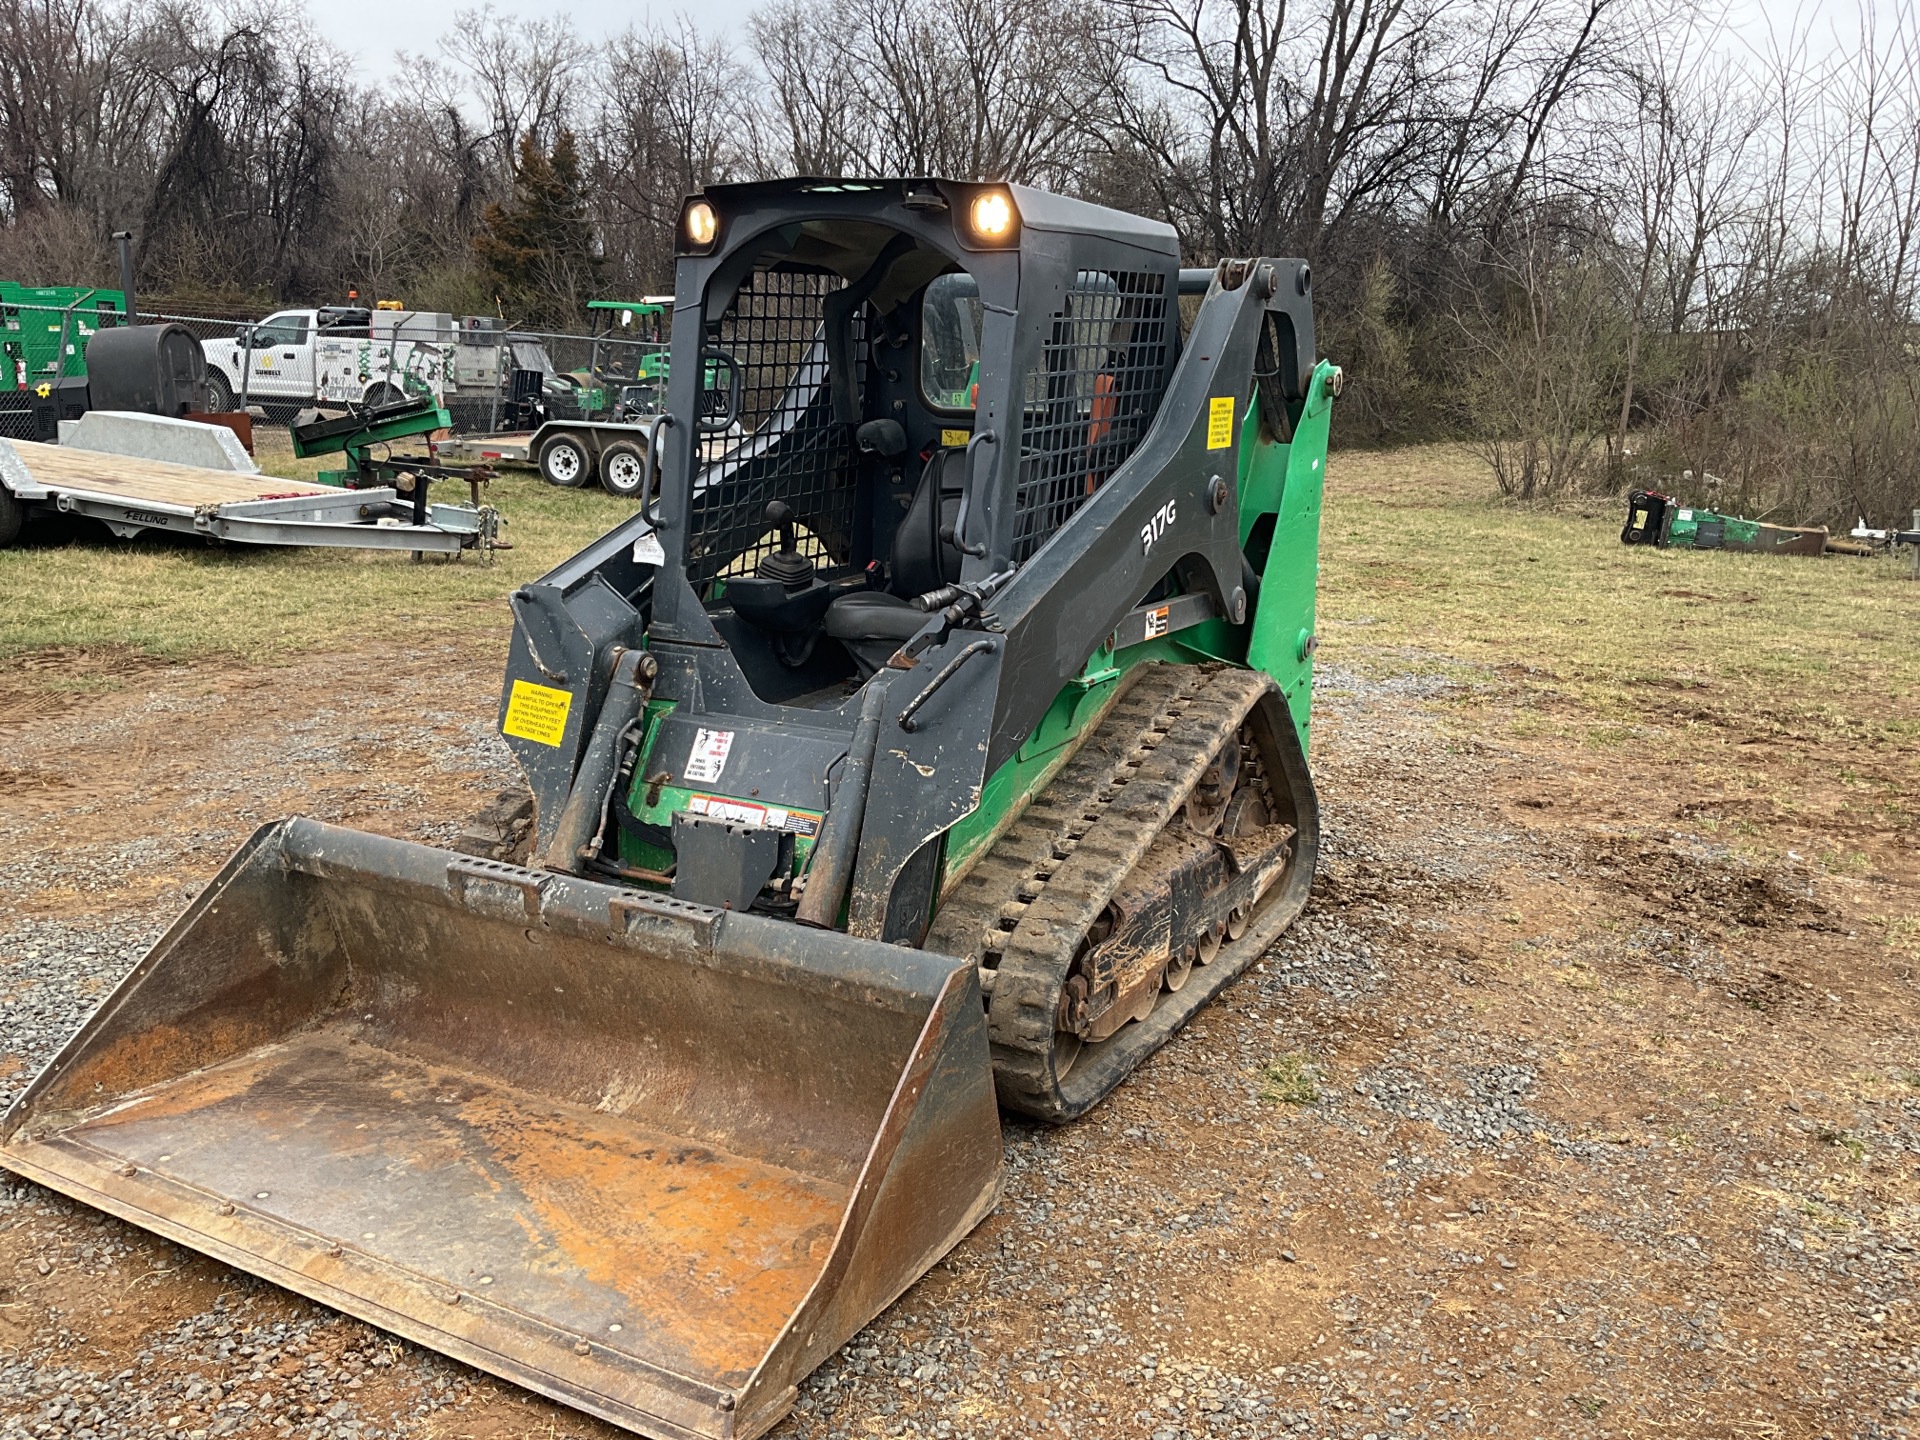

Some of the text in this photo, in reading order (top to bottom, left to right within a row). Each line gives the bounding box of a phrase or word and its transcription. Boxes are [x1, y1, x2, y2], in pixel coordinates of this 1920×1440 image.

[122, 510, 168, 526] FELLING
[1141, 498, 1176, 556] 317G
[513, 694, 538, 703] UNLAWFUL
[531, 690, 552, 698] WARNING
[530, 712, 548, 722] TWENTY
[520, 718, 545, 729] OVERHEAD
[516, 725, 536, 734] VOLTAGE
